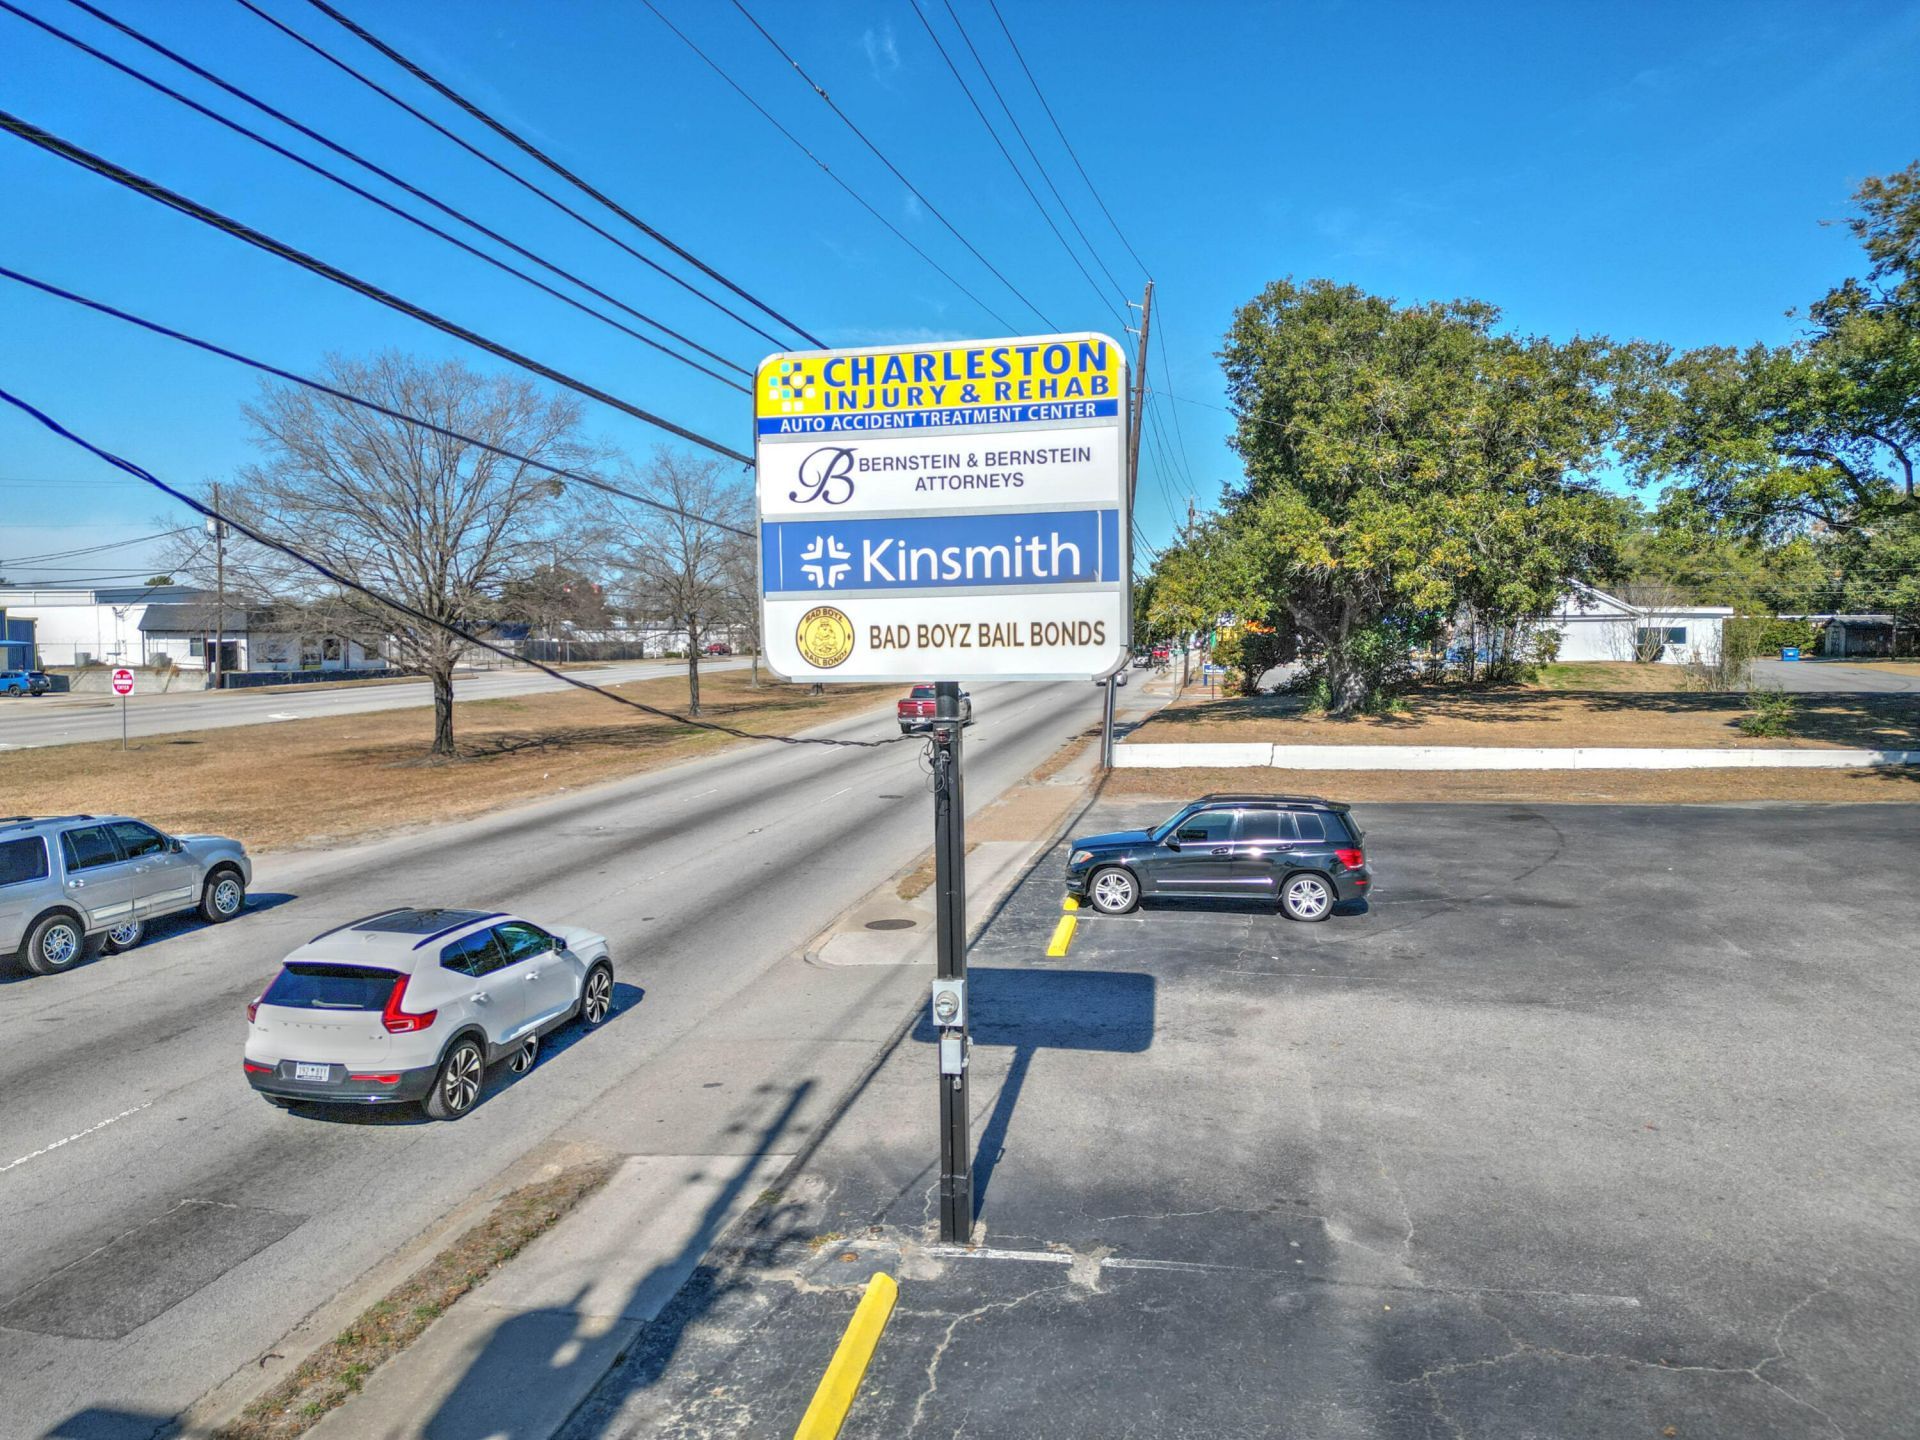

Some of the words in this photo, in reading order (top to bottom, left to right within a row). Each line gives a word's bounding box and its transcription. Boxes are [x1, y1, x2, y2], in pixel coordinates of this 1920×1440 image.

[823, 341, 1107, 387] CHARLESTON
[824, 385, 946, 410] INJURY
[960, 383, 981, 403] &
[994, 375, 1109, 401] REHAB
[780, 417, 826, 433] AUTO
[831, 412, 915, 430] ACCIDENT
[919, 406, 1022, 426] TREATMENT
[1027, 402, 1097, 421] CENTER
[789, 446, 858, 505] B
[859, 453, 961, 473] BERNSTEIN
[967, 452, 979, 468] &
[984, 447, 1092, 468] BERNSTEIN
[915, 472, 1025, 492] ATTORNEYS
[863, 532, 1081, 582] Kinsmith
[869, 624, 911, 649] BAD
[917, 623, 972, 648] BOYZ
[978, 622, 1025, 647] BAIL
[1031, 621, 1106, 646] BONDS
